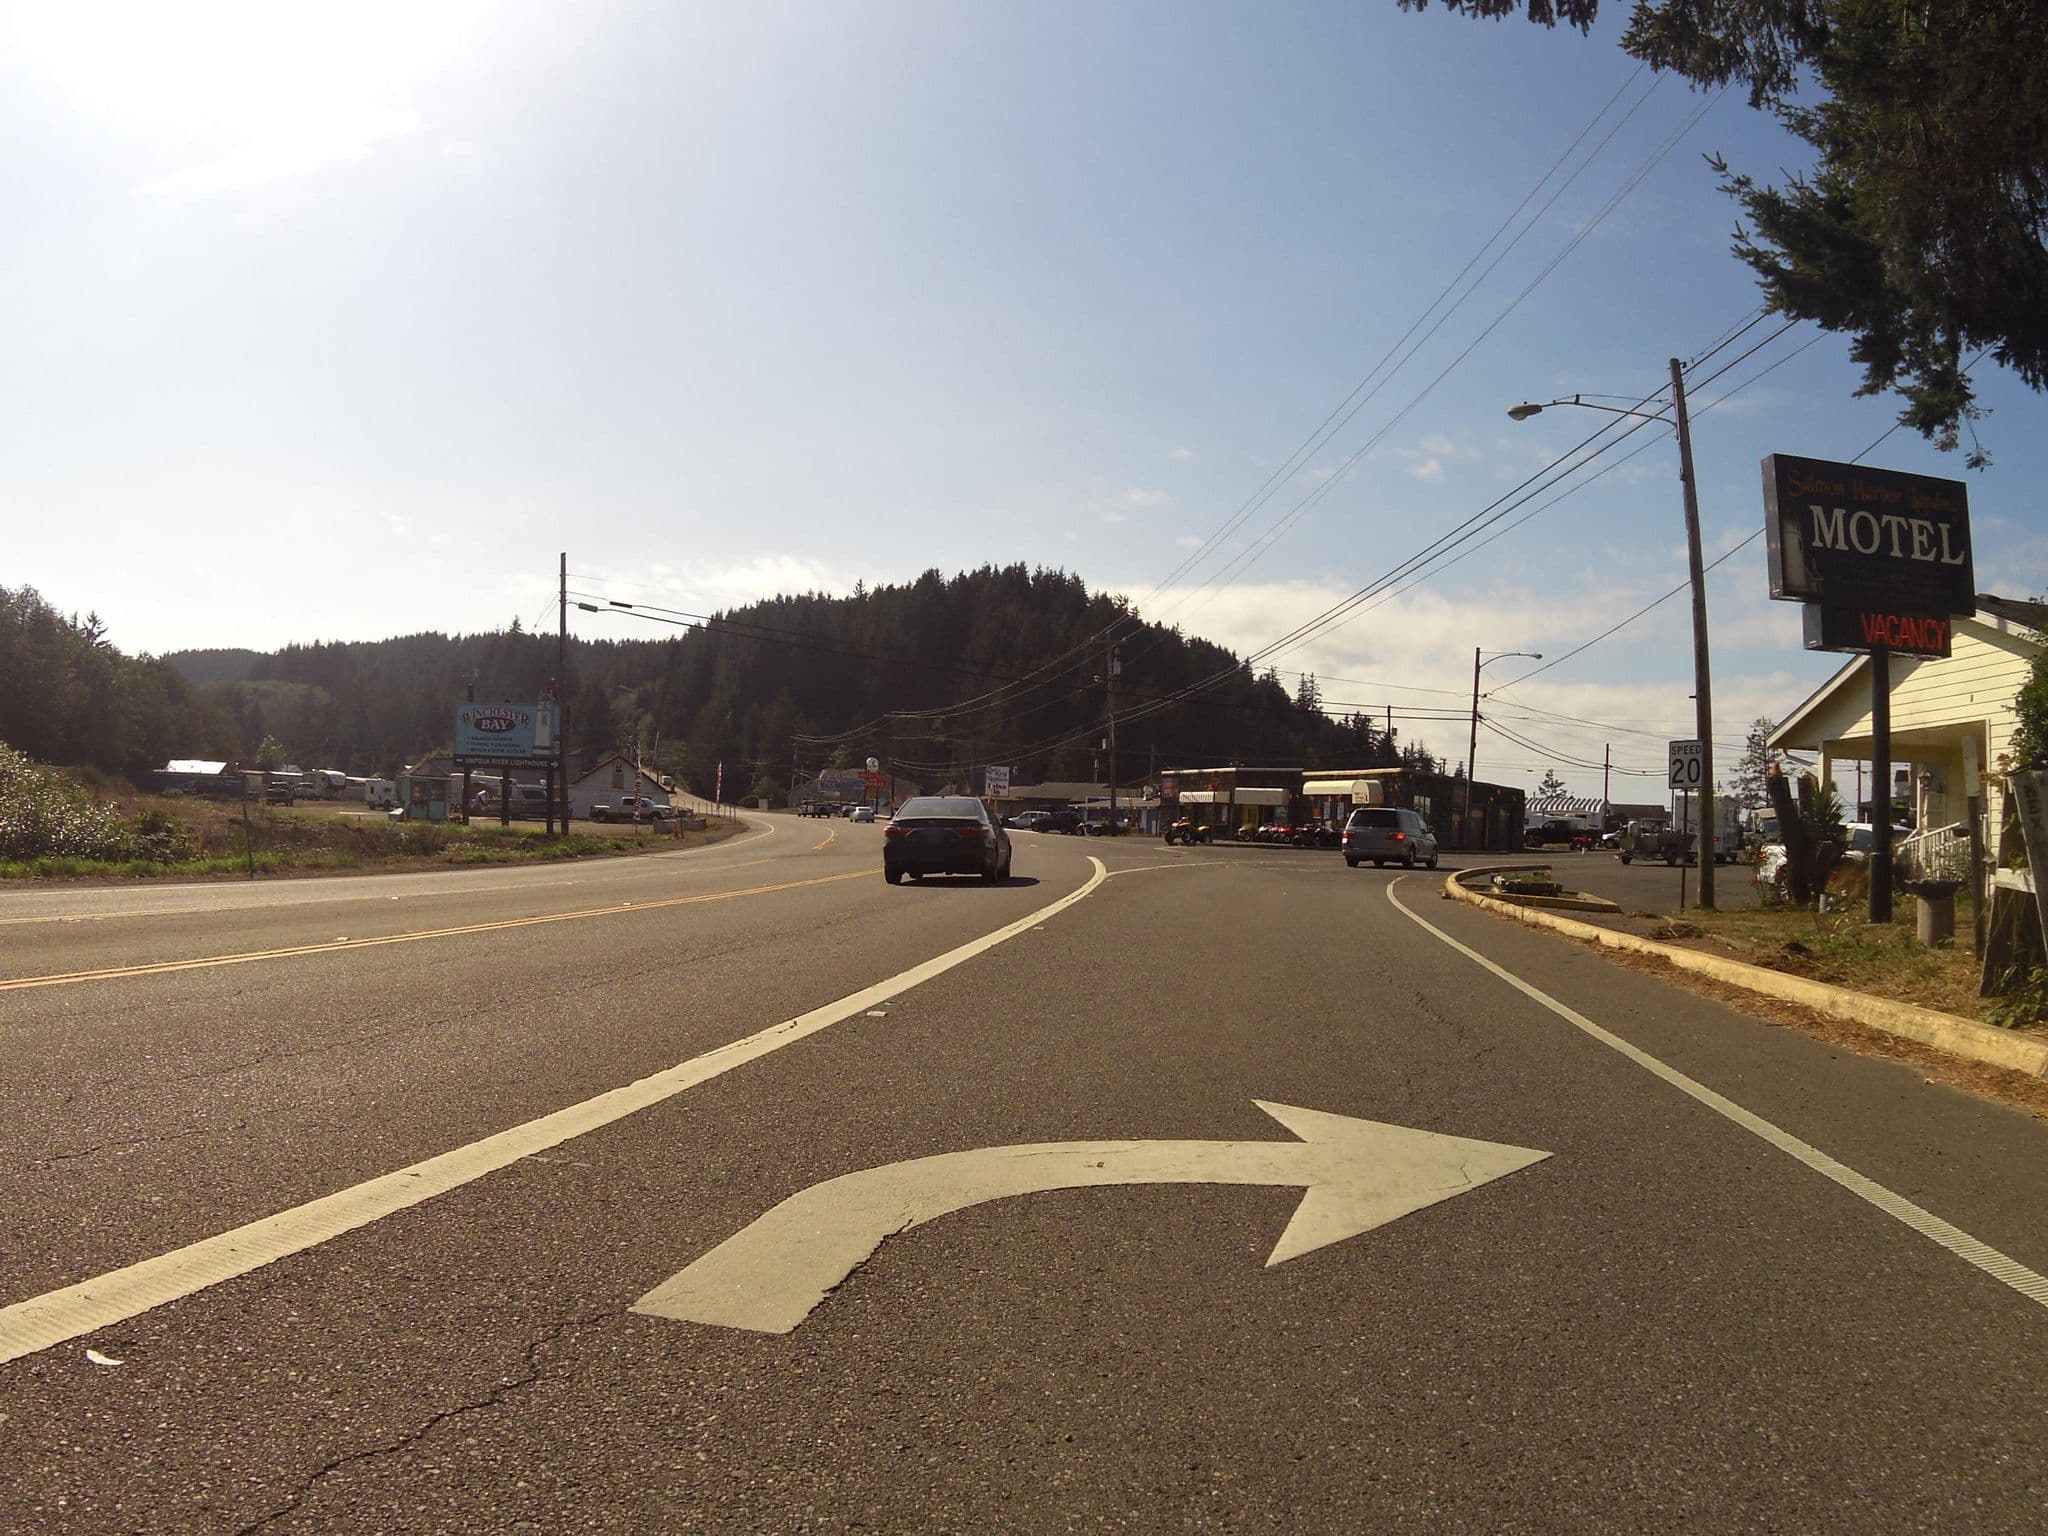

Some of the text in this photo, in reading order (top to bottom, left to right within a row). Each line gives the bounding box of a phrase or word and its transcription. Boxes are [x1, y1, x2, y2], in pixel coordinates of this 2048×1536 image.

[1809, 505, 1965, 565] MOTEL
[1860, 612, 1947, 650] VACANCY
[463, 706, 529, 727] WINCHESTER
[480, 719, 509, 729] BAY
[1671, 745, 1702, 755] SPEED
[1672, 758, 1700, 784] 20
